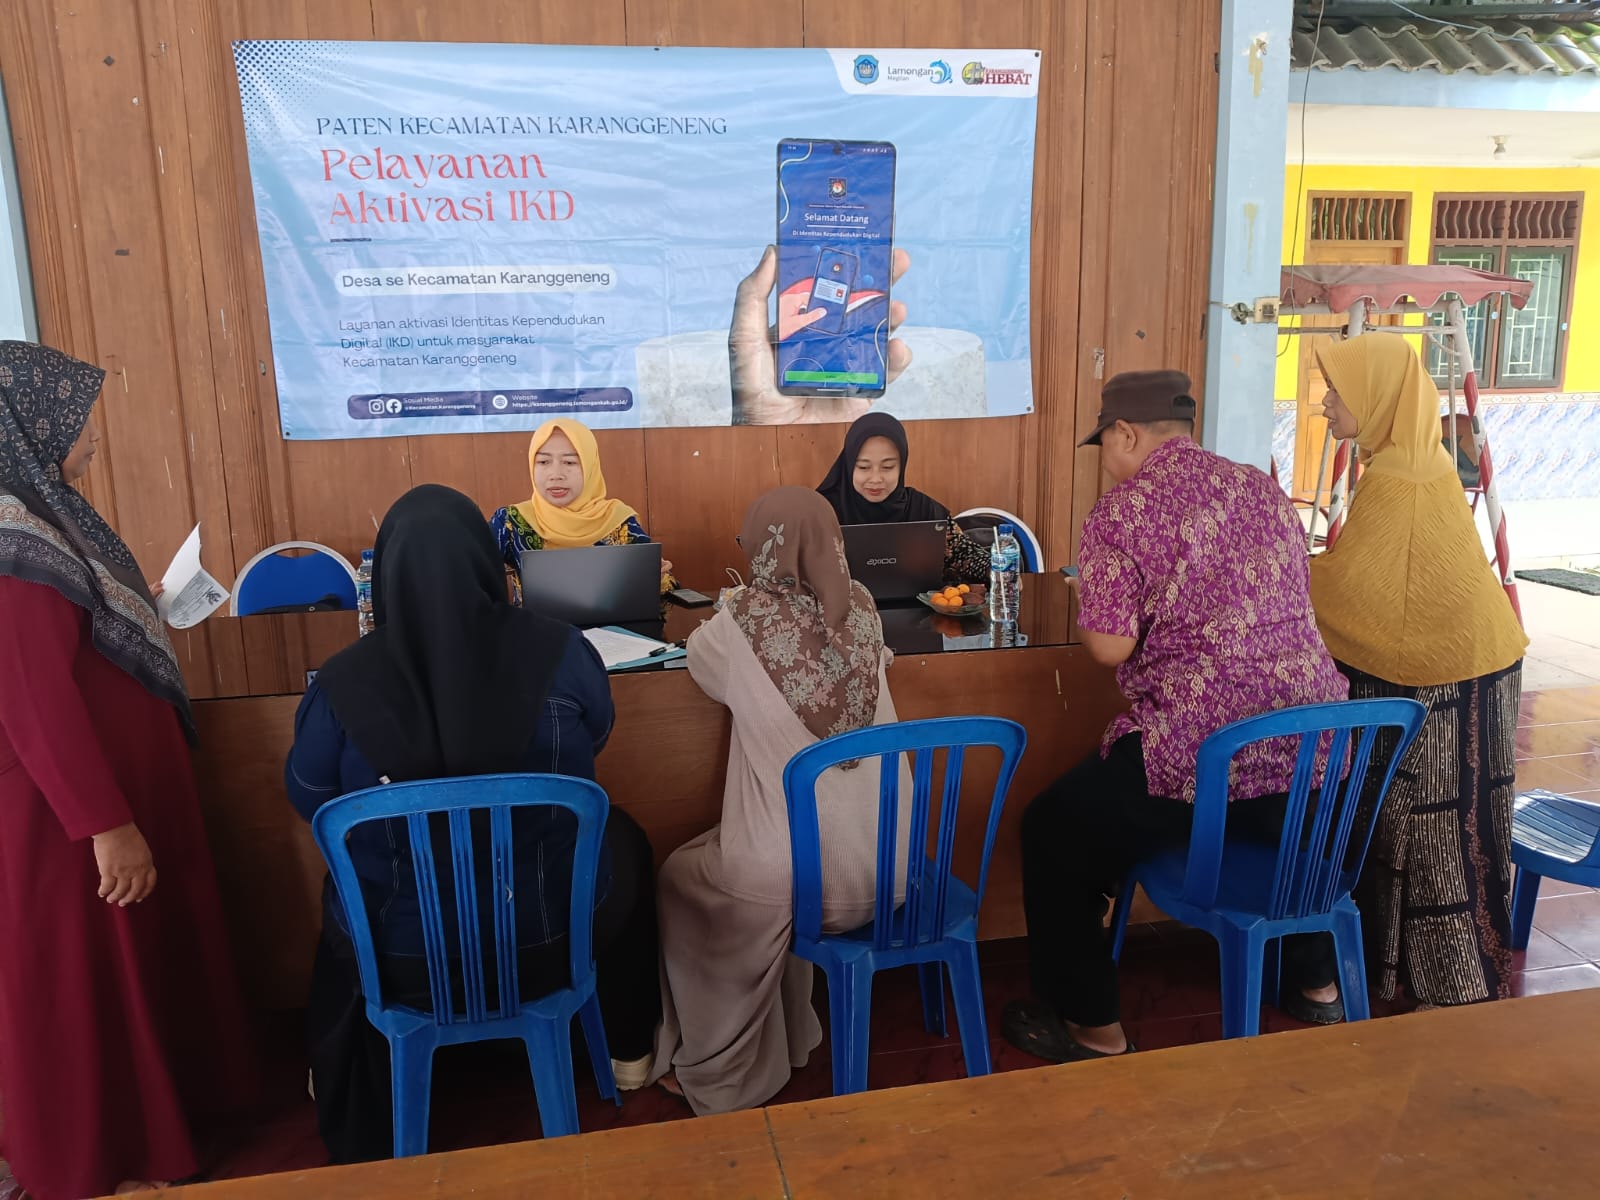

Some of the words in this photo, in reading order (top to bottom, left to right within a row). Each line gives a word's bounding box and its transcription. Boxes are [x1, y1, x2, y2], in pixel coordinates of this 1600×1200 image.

[887, 66, 934, 78] Lamongan
[984, 73, 1032, 85] HEBAT
[316, 117, 392, 135] PATEN
[400, 116, 541, 135] KECAMATAN
[549, 116, 728, 135] KARANGGENENG
[321, 147, 548, 189] Pelayanan
[328, 190, 496, 225] Aktivasi
[508, 189, 575, 222] IKD
[804, 213, 838, 222] Selamat
[840, 214, 869, 225] Datang
[342, 275, 382, 288] Desa
[385, 275, 404, 287] se
[407, 272, 497, 286] Kecamatan
[500, 271, 610, 287] Karanggeneng
[339, 319, 396, 333] Layanan
[398, 316, 448, 329] aktivasi
[451, 315, 509, 328] Identitas
[512, 314, 605, 328] Kependudukan
[341, 337, 383, 352] Digital
[385, 335, 414, 350] (IKD)
[416, 336, 453, 348] untuk
[456, 333, 536, 348] masyarakat
[343, 355, 419, 368] Kecamatan
[421, 353, 517, 367] Karanggeneng
